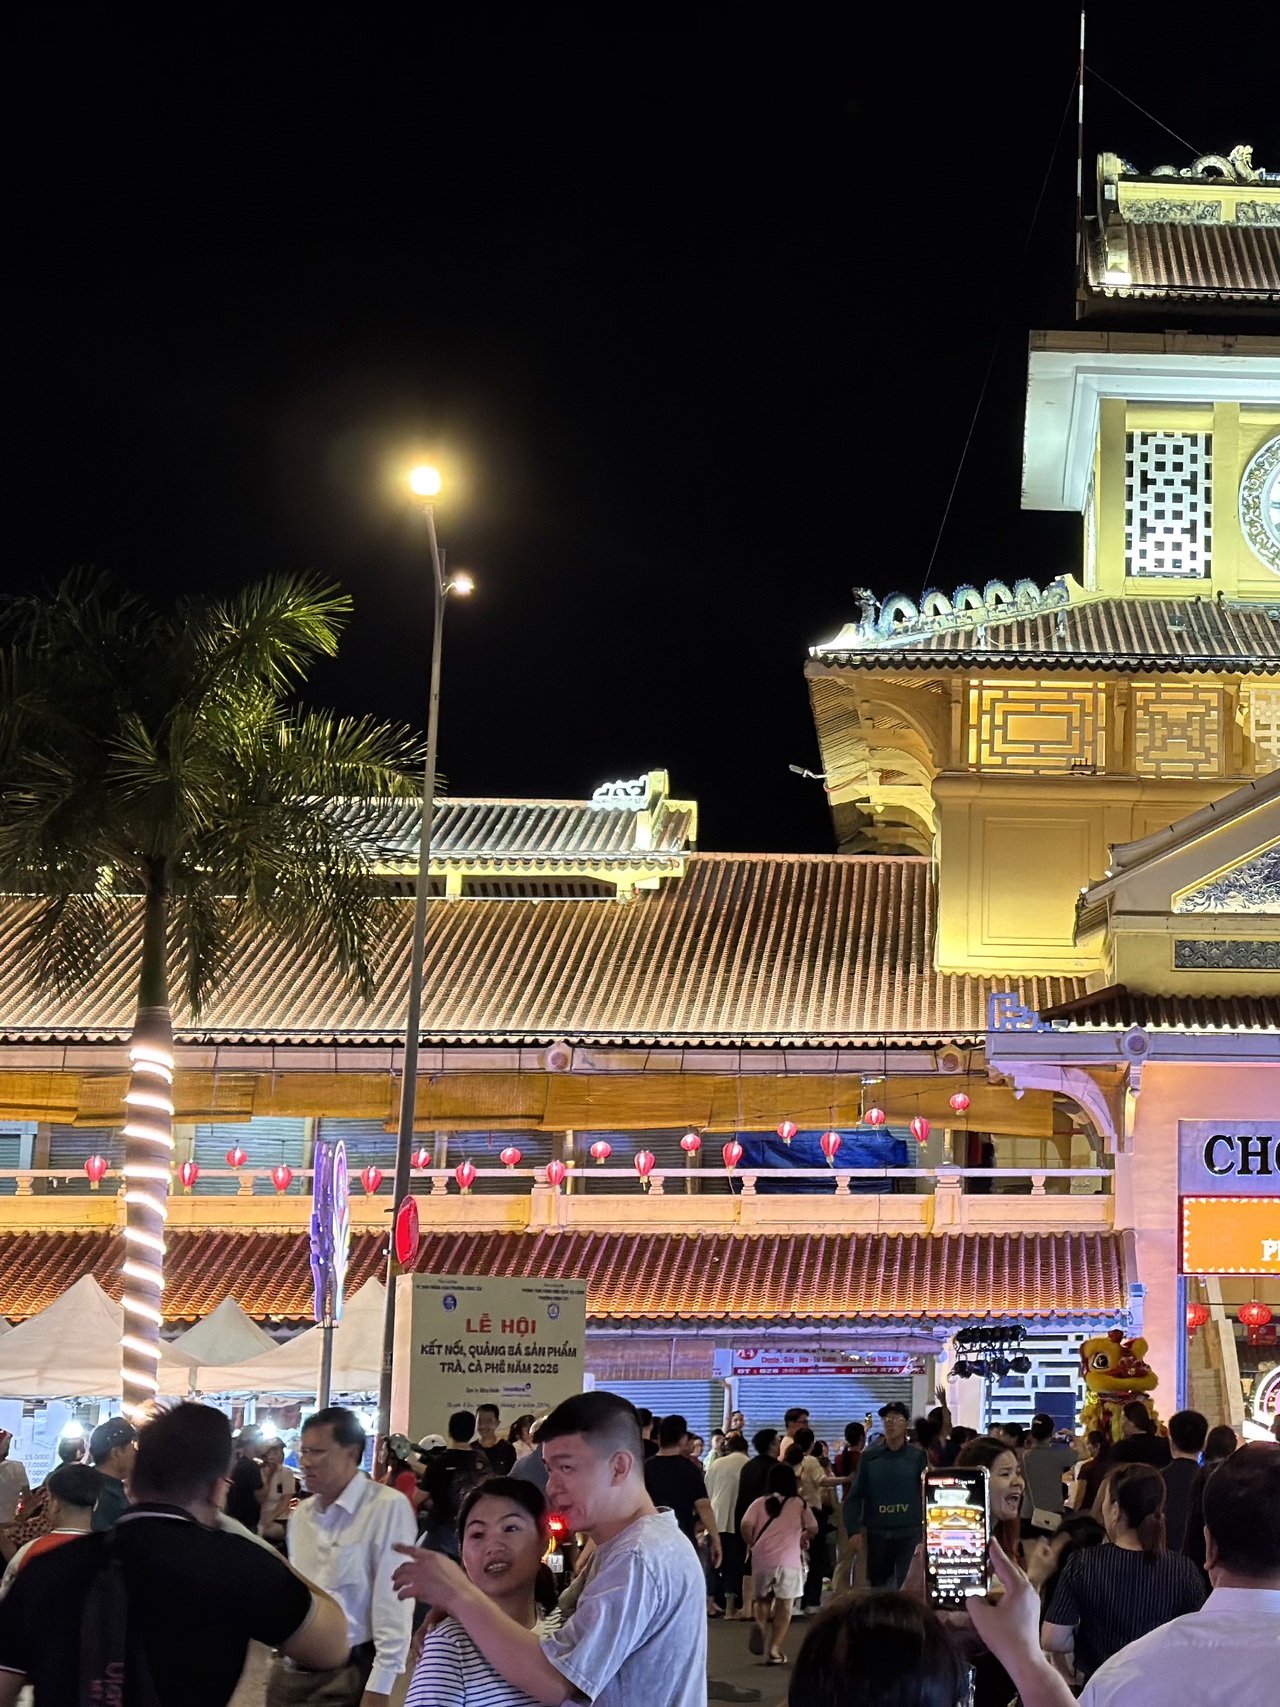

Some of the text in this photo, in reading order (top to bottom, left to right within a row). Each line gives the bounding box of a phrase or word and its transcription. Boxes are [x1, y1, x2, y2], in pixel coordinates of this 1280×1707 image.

[465, 1313, 536, 1338] LỄ HỘI
[420, 1339, 443, 1356] KẾT
[468, 1341, 506, 1357] QUẢNG
[507, 1342, 522, 1357] BÁ
[524, 1341, 546, 1357] SẢN
[547, 1340, 577, 1358] PHẨM
[467, 1360, 483, 1374] CÀ
[484, 1360, 505, 1374] PHÊ
[507, 1360, 532, 1375] NĂM
[533, 1362, 559, 1374] 2026
[878, 1503, 909, 1514] DQTV
